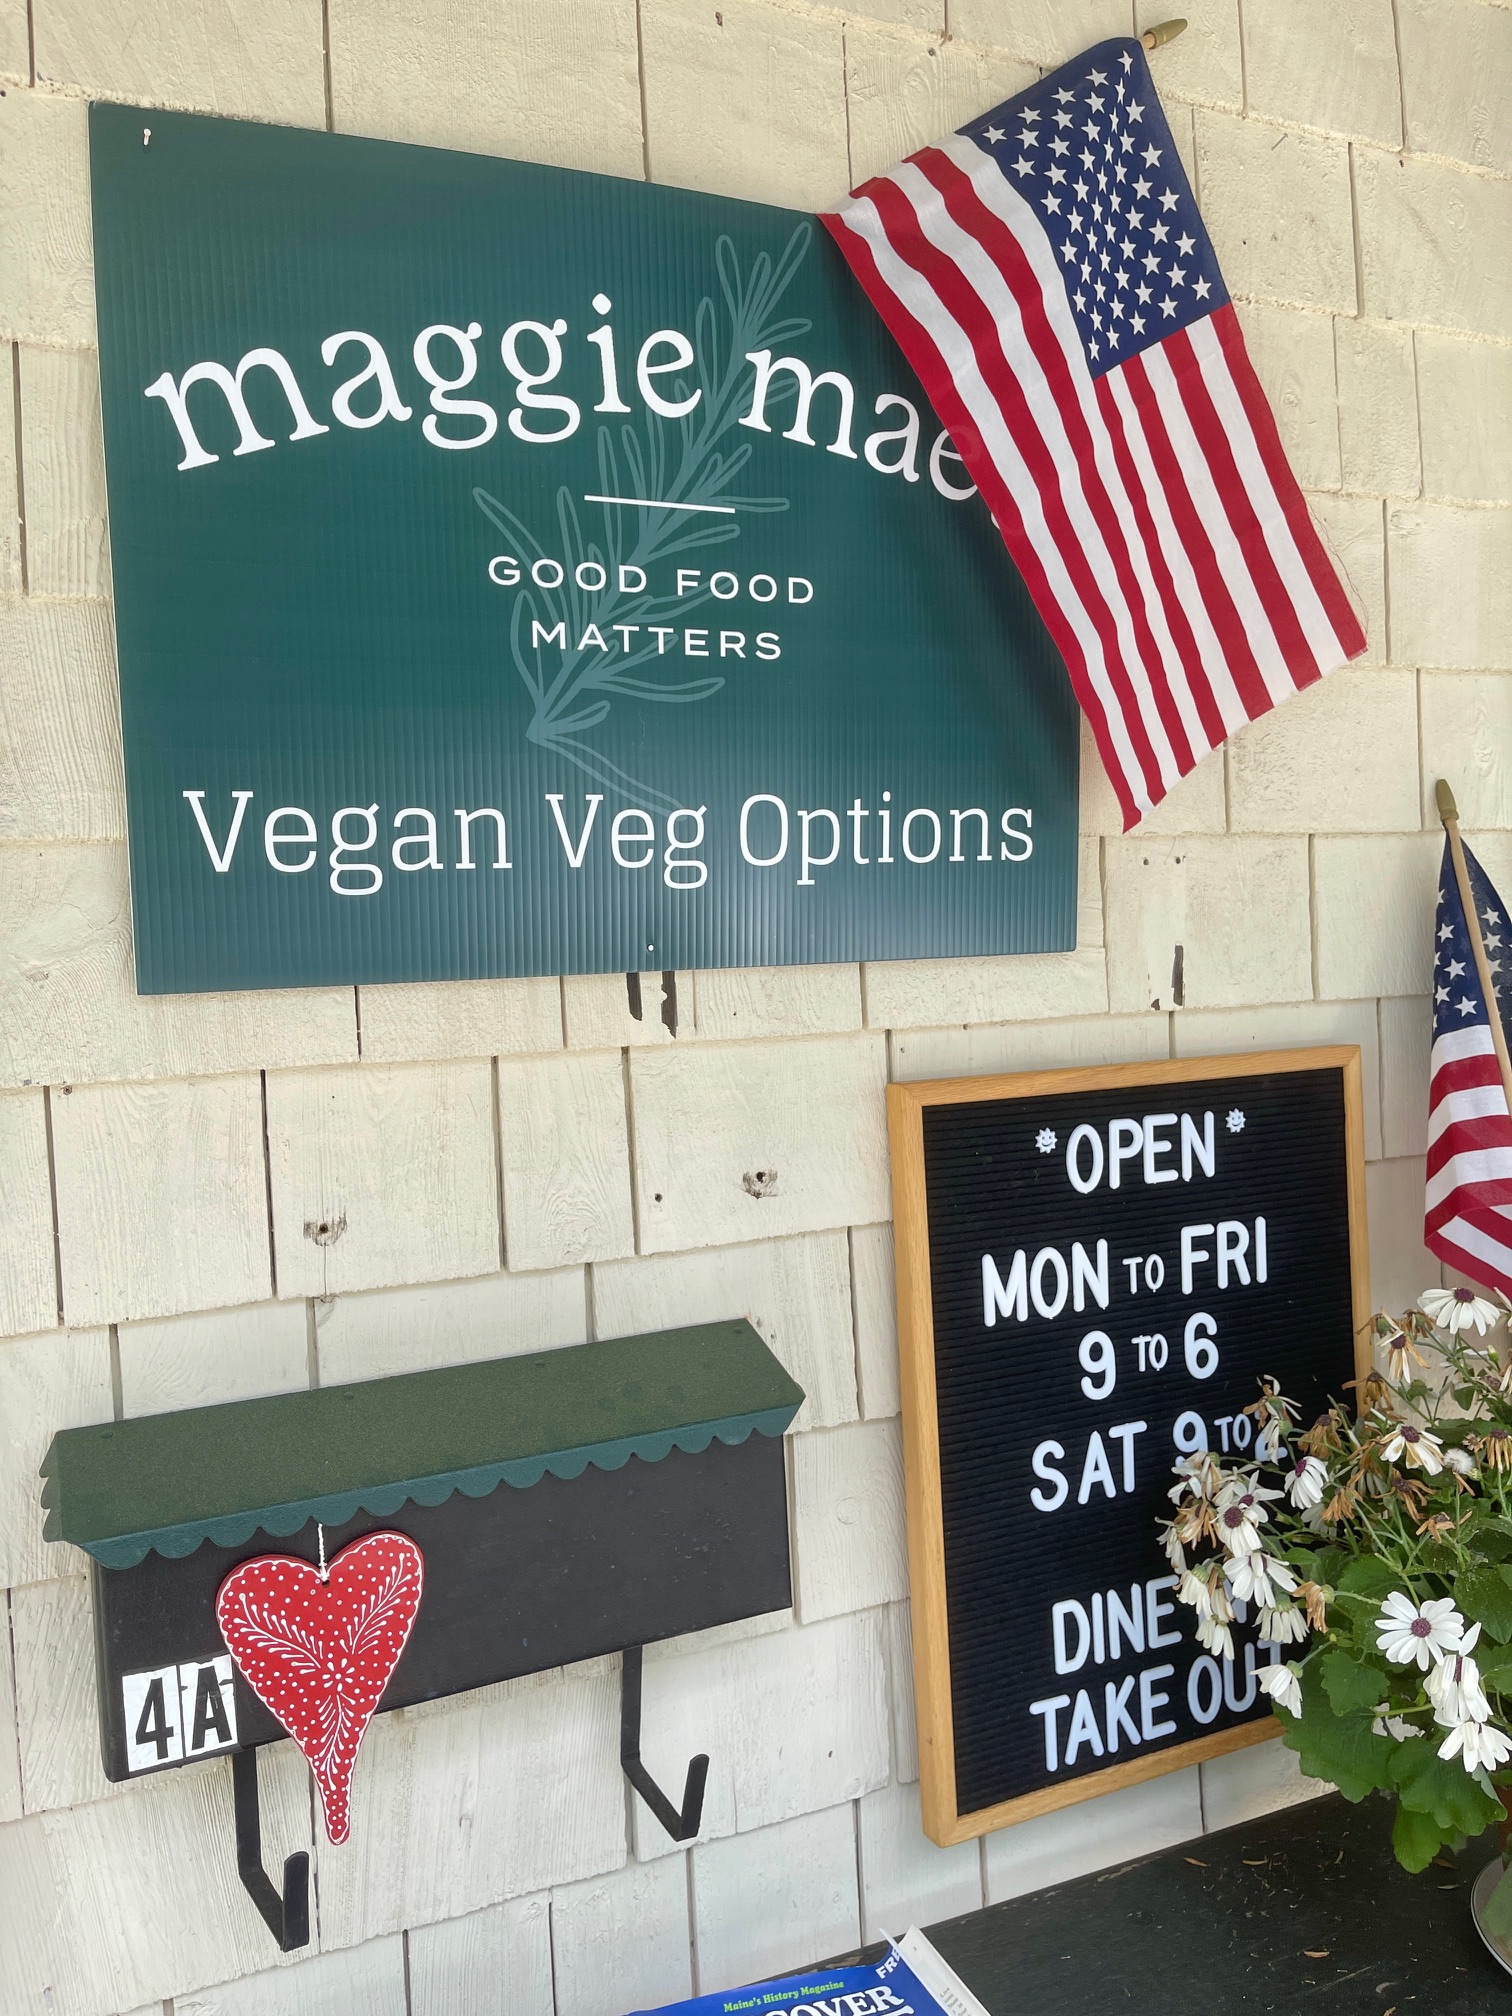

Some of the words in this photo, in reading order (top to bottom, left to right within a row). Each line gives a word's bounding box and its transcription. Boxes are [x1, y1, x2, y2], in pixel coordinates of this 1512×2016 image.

[144, 293, 702, 471] maggie
[738, 349, 980, 502] mae
[487, 555, 647, 593] GOOD
[676, 569, 814, 605] FOOD
[531, 620, 782, 660] MATTERS
[182, 789, 513, 896] Vegan
[545, 793, 708, 890] Veg
[739, 790, 1034, 886] Options
[1065, 1110, 1216, 1195] OPEN
[981, 1238, 1110, 1328] MON
[1122, 1253, 1165, 1295] TO
[1181, 1216, 1268, 1296] FRI
[1078, 1330, 1116, 1400] 9
[1131, 1332, 1169, 1373] TO
[1183, 1312, 1219, 1380] 6
[1029, 1420, 1148, 1513] SAT
[1213, 1413, 1252, 1453] TO
[1051, 1574, 1184, 1676] DINE
[1028, 1663, 1178, 1773] TAKE
[723, 1996, 762, 2013] Maine's
[762, 1990, 800, 2006] History
[800, 1980, 845, 1998] Magazine
[874, 1947, 901, 1980] FRE
